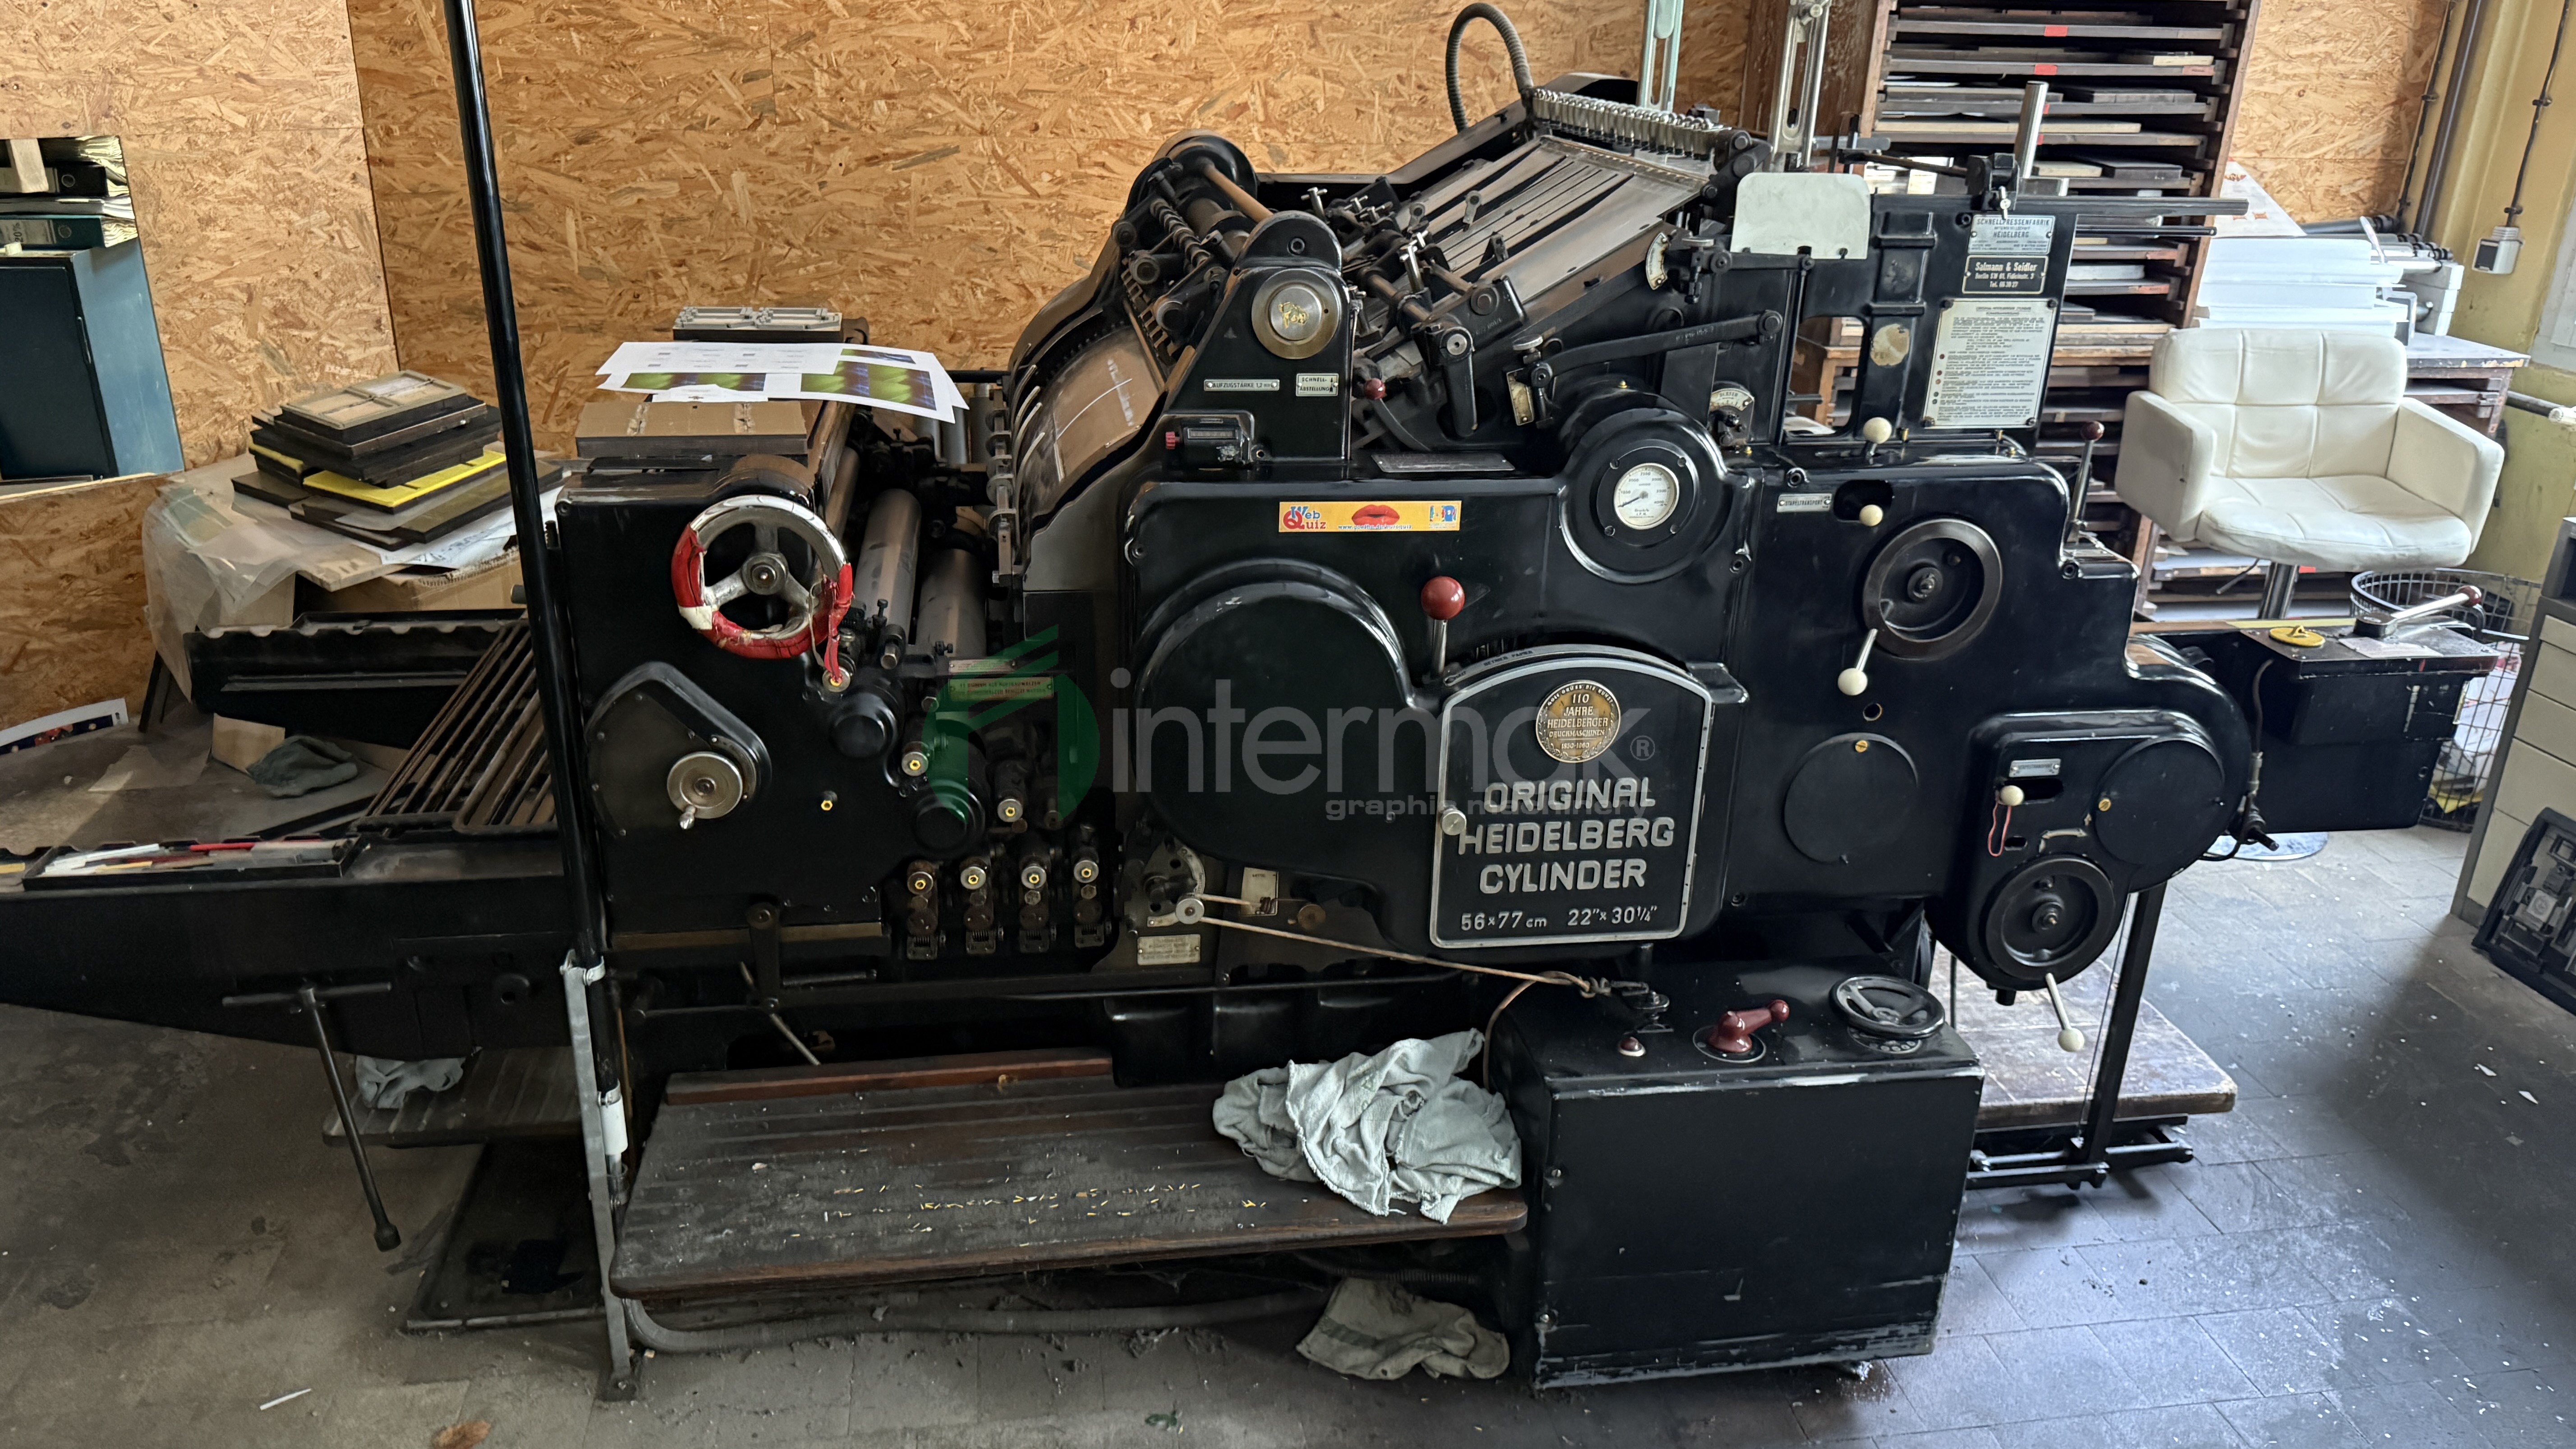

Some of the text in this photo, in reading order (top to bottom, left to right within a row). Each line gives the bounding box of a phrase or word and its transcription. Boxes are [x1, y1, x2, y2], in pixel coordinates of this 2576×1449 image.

[2006, 262, 2011, 271] &
[2013, 262, 2038, 271] Seidler
[1291, 506, 1320, 519] Web
[1283, 510, 1326, 529] Quiz
[1573, 694, 1590, 704] 110
[1564, 706, 1594, 717] JAHRE
[1547, 718, 1608, 729] HEIDELBERGER
[1549, 729, 1605, 738] DRUCKMASCHINEN
[1484, 777, 1656, 813] ORIGINAL
[1458, 817, 1675, 856] HEIDELBERG
[1480, 858, 1647, 894] CYLINDER
[1526, 917, 1547, 928] cm
